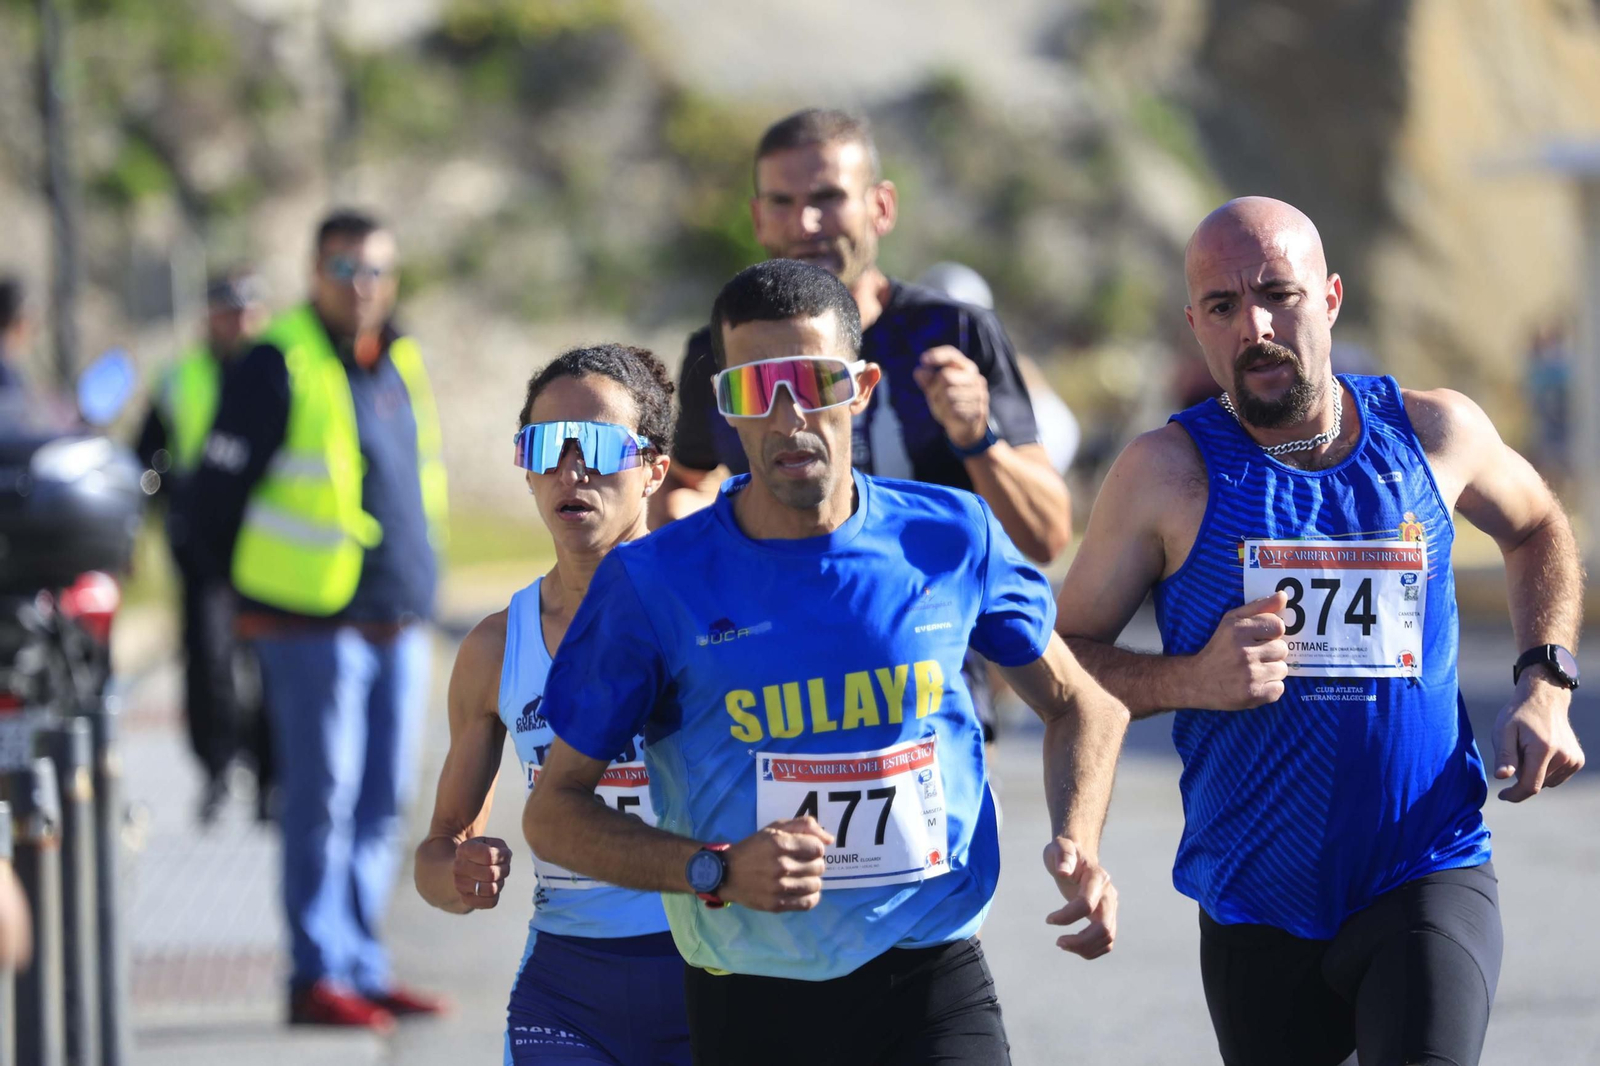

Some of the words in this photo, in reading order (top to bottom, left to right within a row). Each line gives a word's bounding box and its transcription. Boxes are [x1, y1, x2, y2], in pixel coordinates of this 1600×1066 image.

[1283, 550, 1336, 562] CARRERA
[1337, 551, 1360, 562] DEL
[1361, 551, 1420, 562] ESTRECHO
[1275, 577, 1376, 636] 374
[1404, 620, 1413, 628] M
[1288, 641, 1328, 651] OTMANE
[725, 659, 944, 743] SULAYR
[1300, 694, 1340, 702] VETERANOS
[1341, 694, 1377, 702] ALGECIRAS
[798, 762, 855, 774] CARRERA
[857, 761, 881, 773] DEL
[882, 747, 932, 769] ESTRECHO
[793, 785, 896, 849] 477
[927, 817, 936, 827] M
